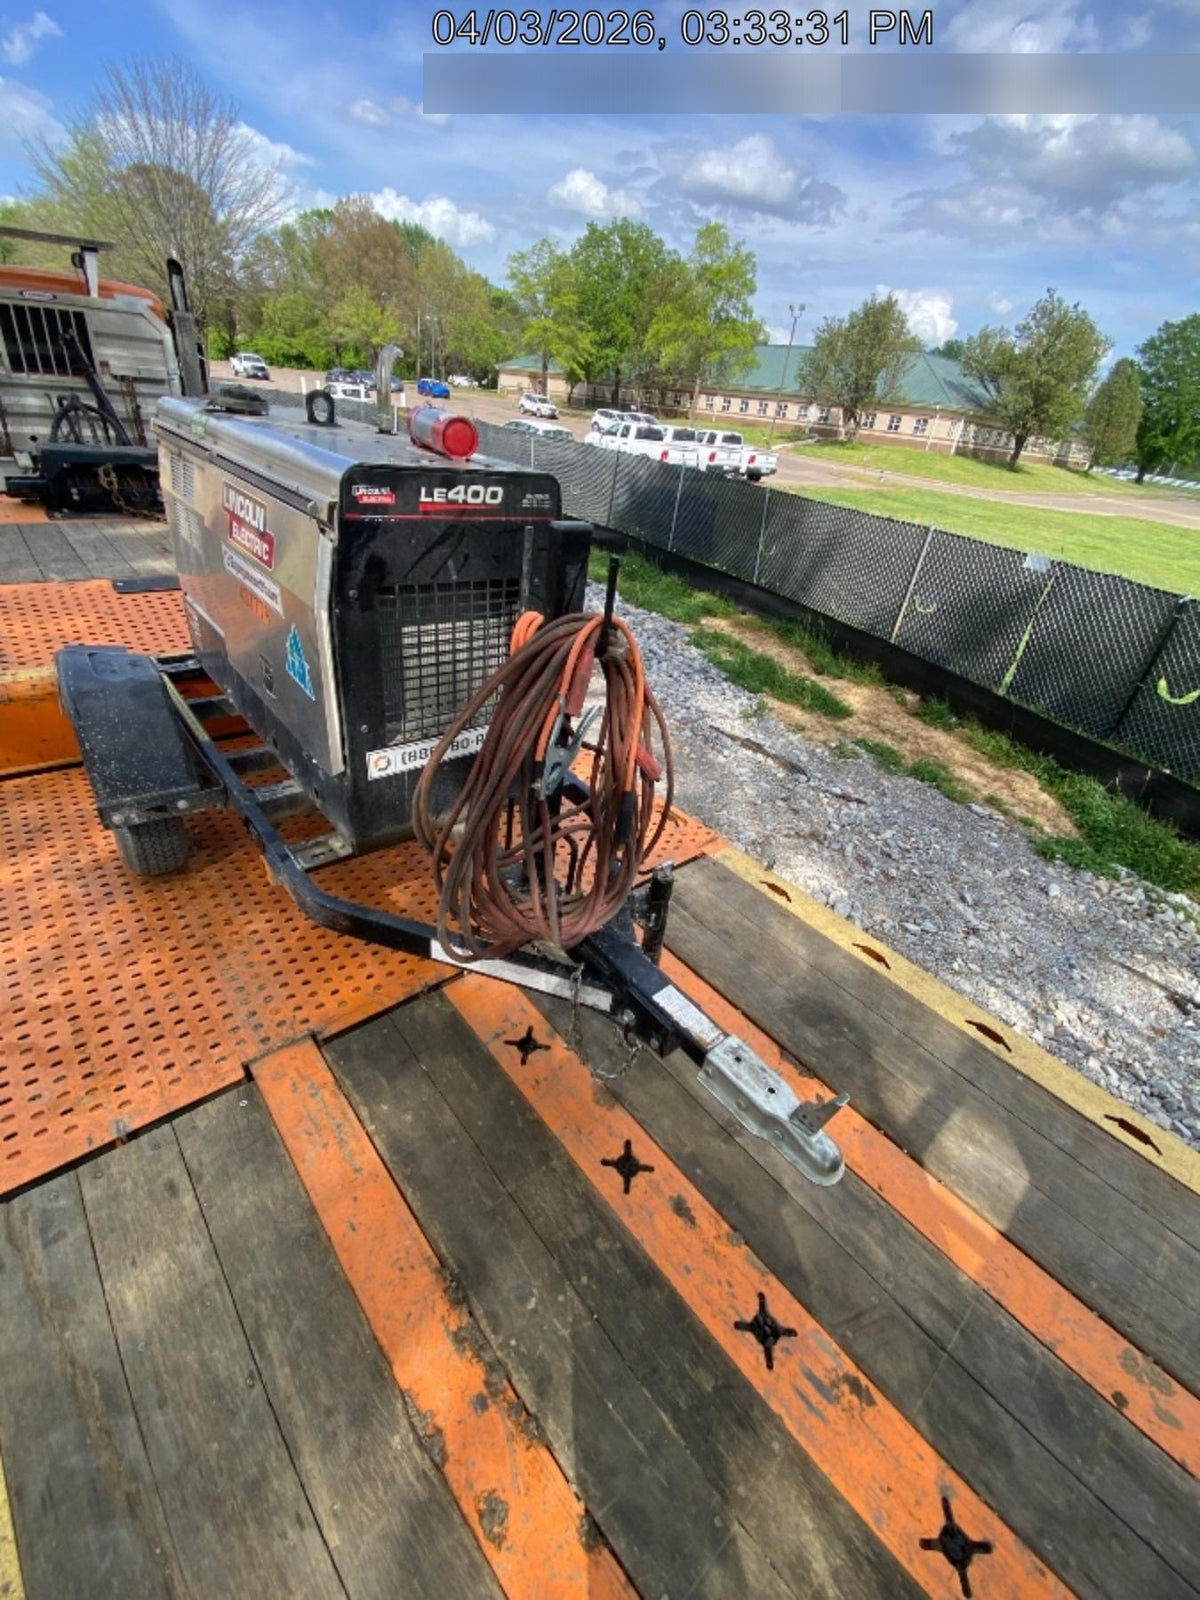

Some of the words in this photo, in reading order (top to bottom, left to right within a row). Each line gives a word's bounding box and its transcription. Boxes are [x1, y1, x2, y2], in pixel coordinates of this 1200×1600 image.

[223, 484, 265, 532] LINCOLN
[420, 484, 504, 504] LE400
[231, 519, 270, 561] ELECTRIC
